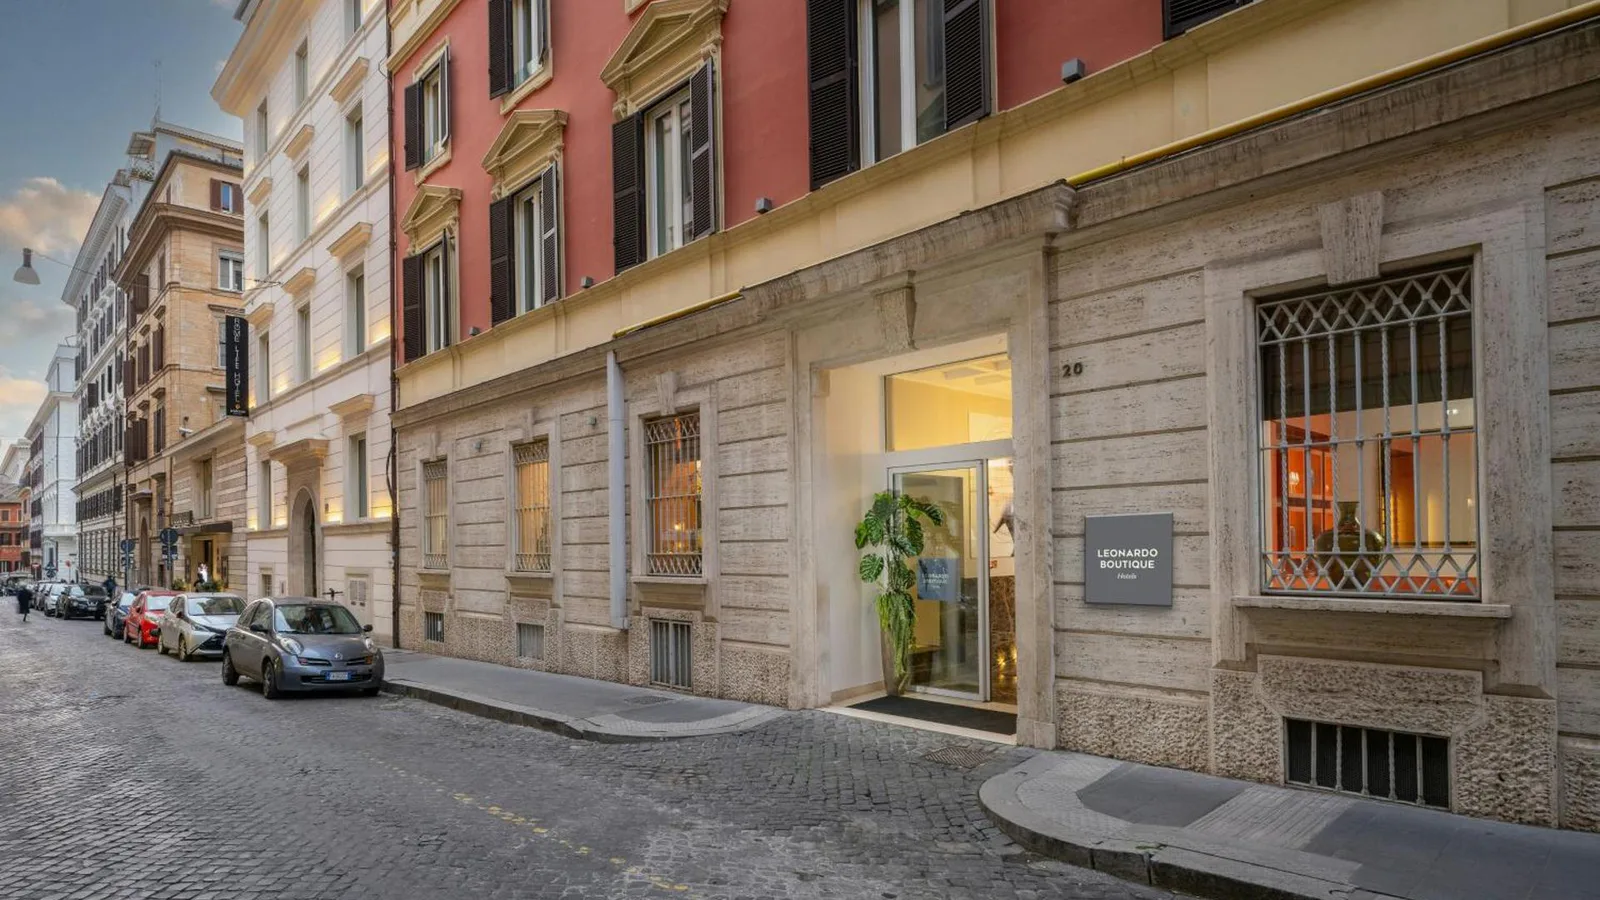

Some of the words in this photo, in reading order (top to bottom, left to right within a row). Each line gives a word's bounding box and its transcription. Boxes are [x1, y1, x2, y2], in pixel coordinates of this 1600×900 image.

[1062, 362, 1083, 378] 20
[1097, 548, 1158, 558] LEONARDO
[1100, 560, 1155, 569] BOUTIQUE
[1117, 572, 1137, 580] Hotels
